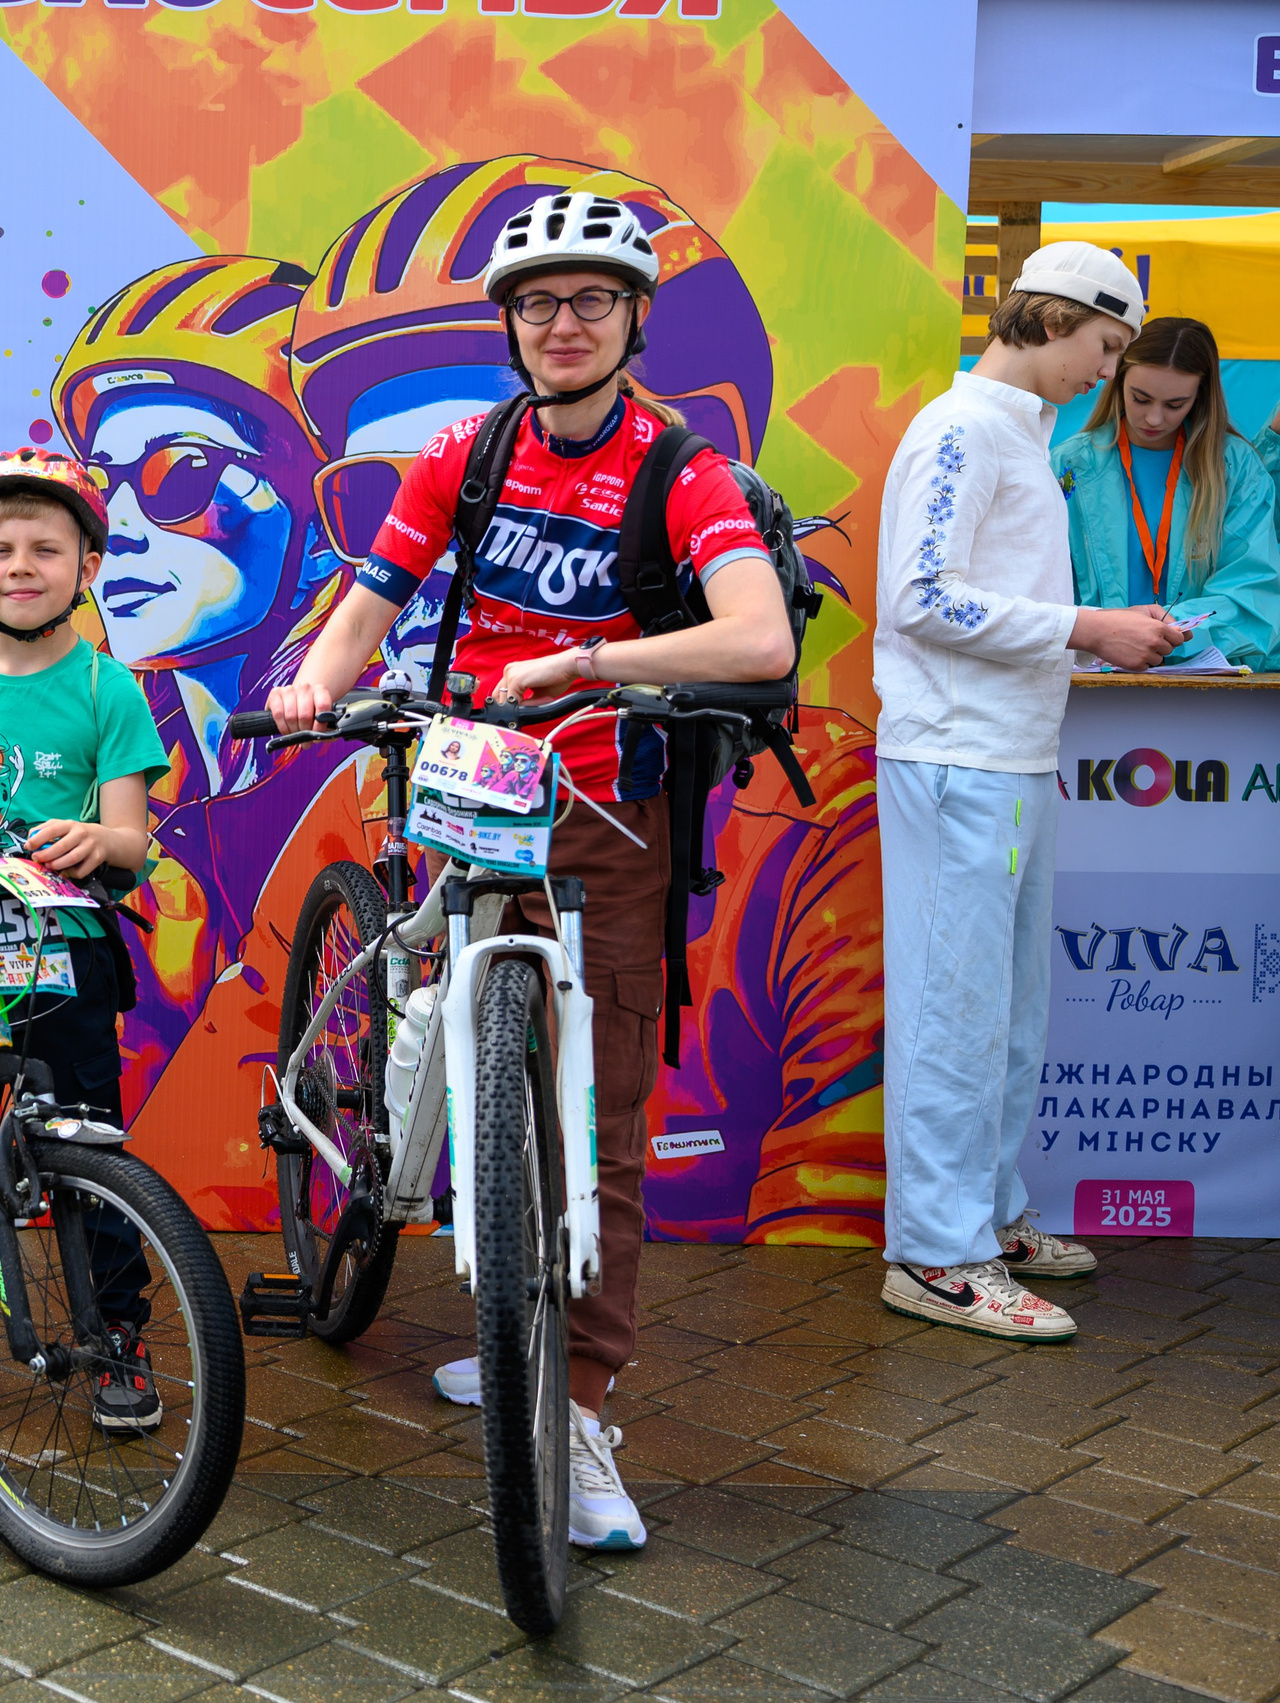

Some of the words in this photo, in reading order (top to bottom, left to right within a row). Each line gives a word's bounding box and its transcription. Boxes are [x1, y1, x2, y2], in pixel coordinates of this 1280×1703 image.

[475, 516, 618, 606] Minsk
[420, 761, 468, 781] 00678
[1055, 922, 1242, 973] VIVA
[1106, 979, 1184, 1020] Ровар
[1042, 1130, 1060, 1151] У
[1078, 1131, 1221, 1153] МІНСКУ
[1102, 1189, 1120, 1204] 31
[1128, 1190, 1165, 1204] МАЯ
[1101, 1206, 1171, 1227] 2025
